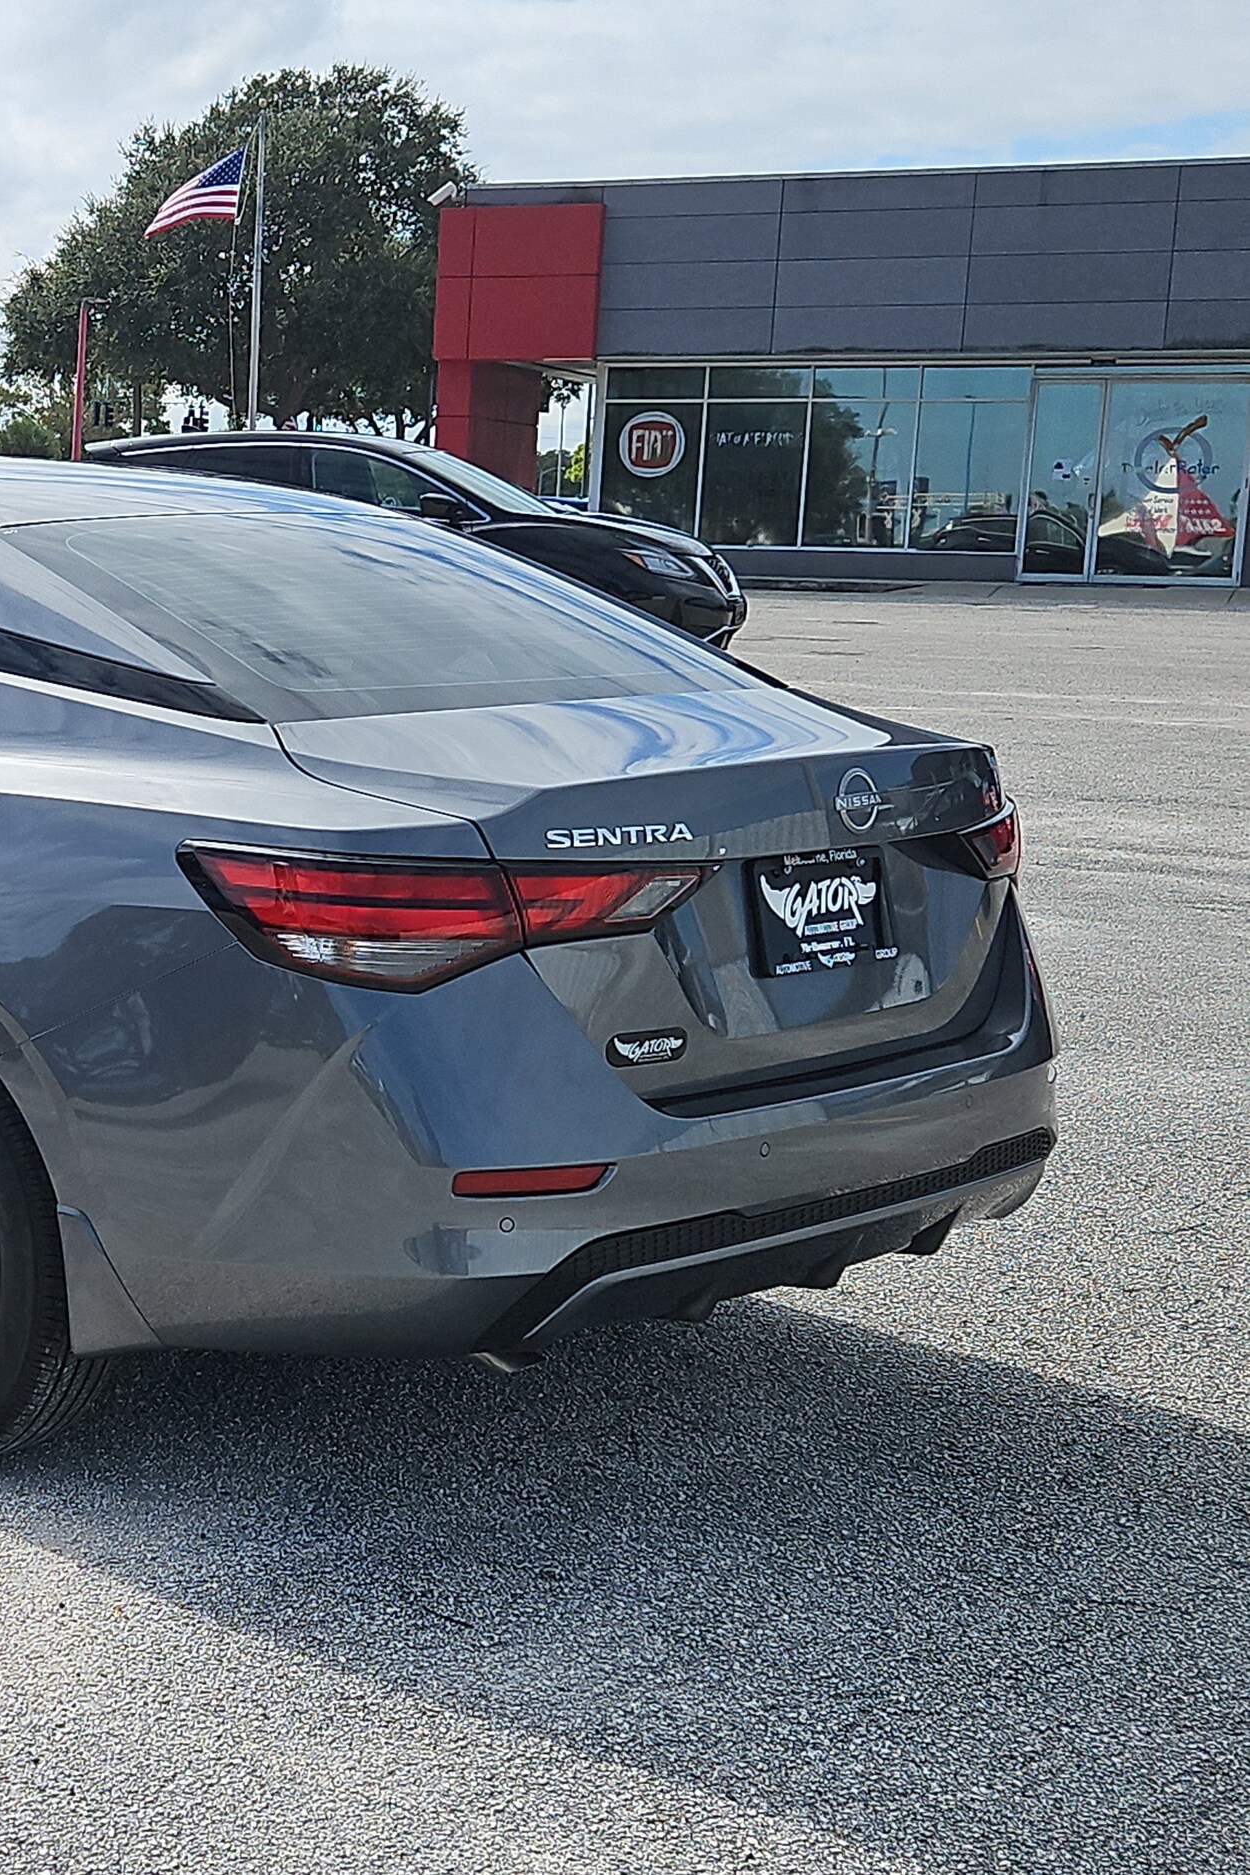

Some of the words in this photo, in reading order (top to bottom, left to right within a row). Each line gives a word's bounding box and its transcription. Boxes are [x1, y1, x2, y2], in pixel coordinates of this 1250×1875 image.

[631, 429, 674, 462] FIAT
[837, 794, 882, 809] NISSAN
[546, 822, 694, 849] SENTRA
[829, 848, 857, 861] Florida
[784, 876, 864, 938] GATOR
[628, 1037, 672, 1063] GATOR
